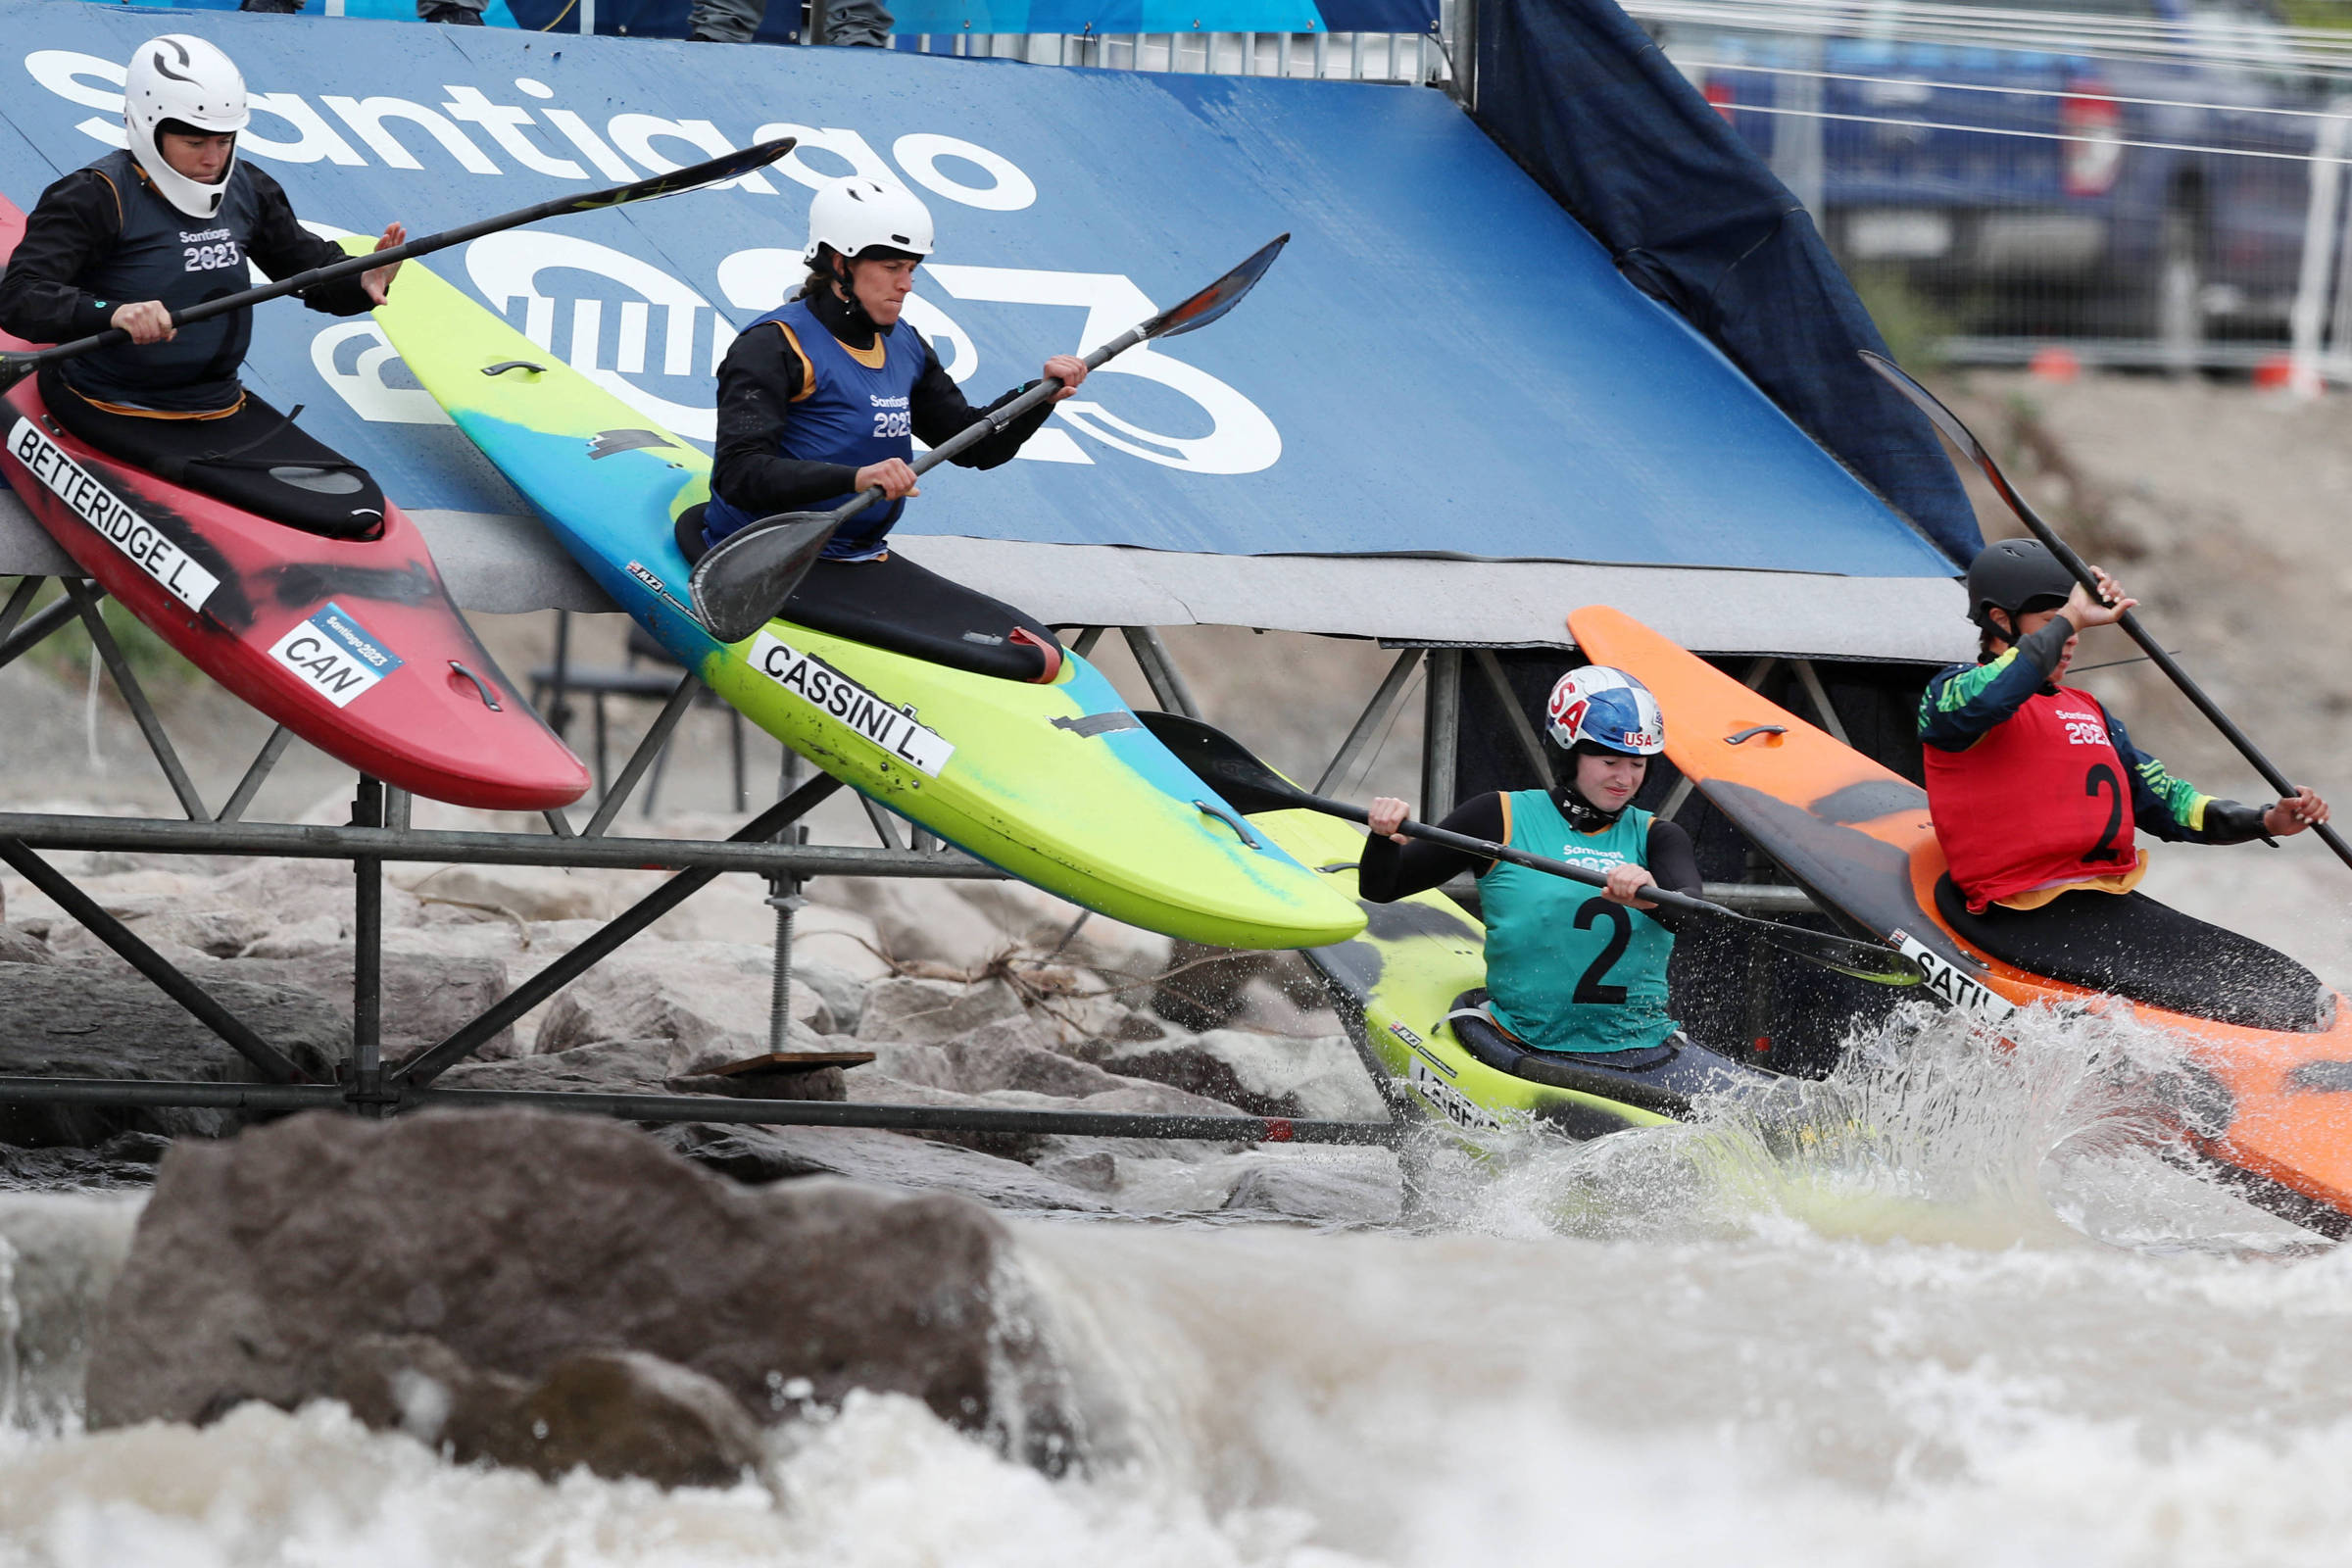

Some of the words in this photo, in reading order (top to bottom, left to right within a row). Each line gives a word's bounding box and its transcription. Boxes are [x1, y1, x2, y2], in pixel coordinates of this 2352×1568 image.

[24, 49, 1037, 212] Santiago
[183, 241, 240, 272] 2023
[18, 428, 172, 575] BETTERIDGE
[169, 560, 189, 599] L.
[285, 637, 365, 694] CAN
[326, 615, 364, 648] Santiago
[357, 641, 388, 667] 2023
[764, 645, 897, 742] CASSINI
[897, 725, 923, 766] L.
[1550, 673, 1588, 740] SA
[1624, 733, 1652, 747] USA
[2082, 762, 2123, 863] 2
[1572, 896, 1632, 1004] 2
